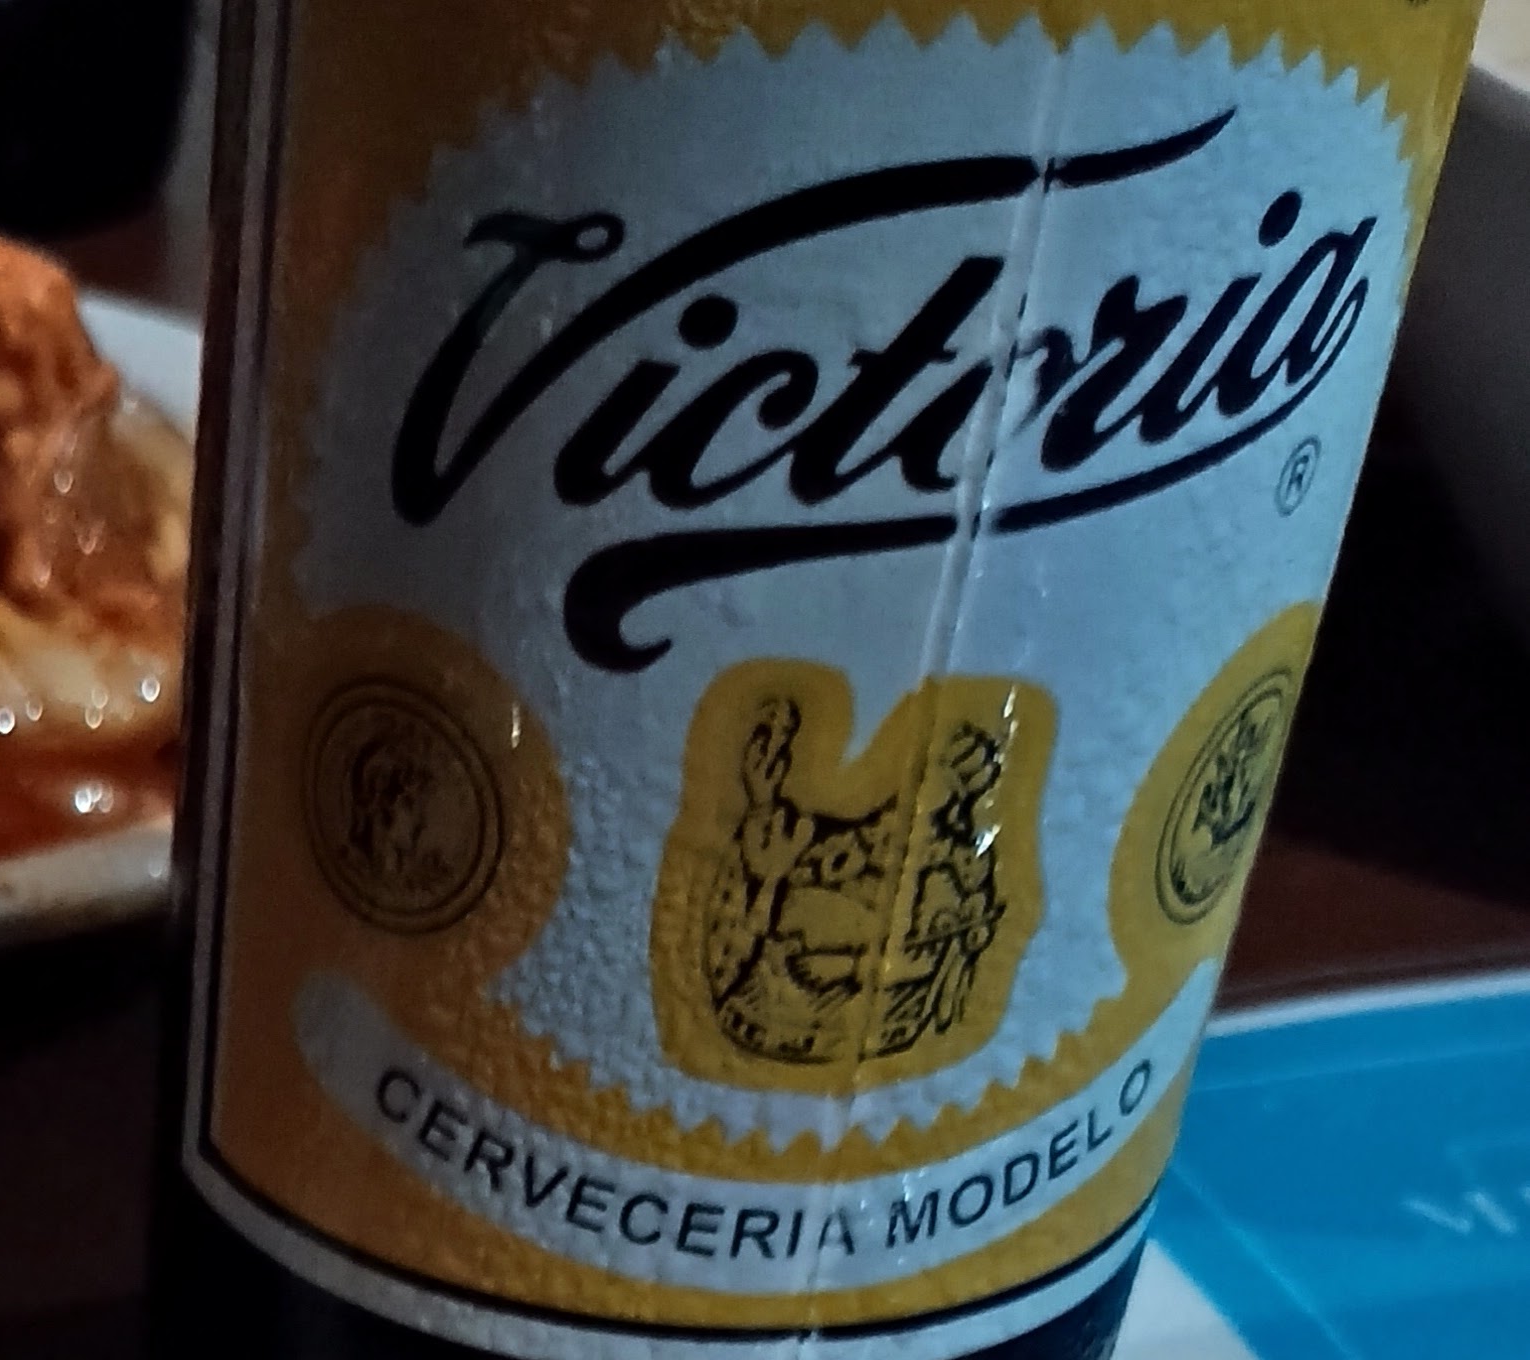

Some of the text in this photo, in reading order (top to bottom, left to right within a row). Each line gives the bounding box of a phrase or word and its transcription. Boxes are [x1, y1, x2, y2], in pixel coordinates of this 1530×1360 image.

[392, 108, 1379, 672] Victoria
[376, 1058, 1154, 1260] CERVECERIA MODELO
